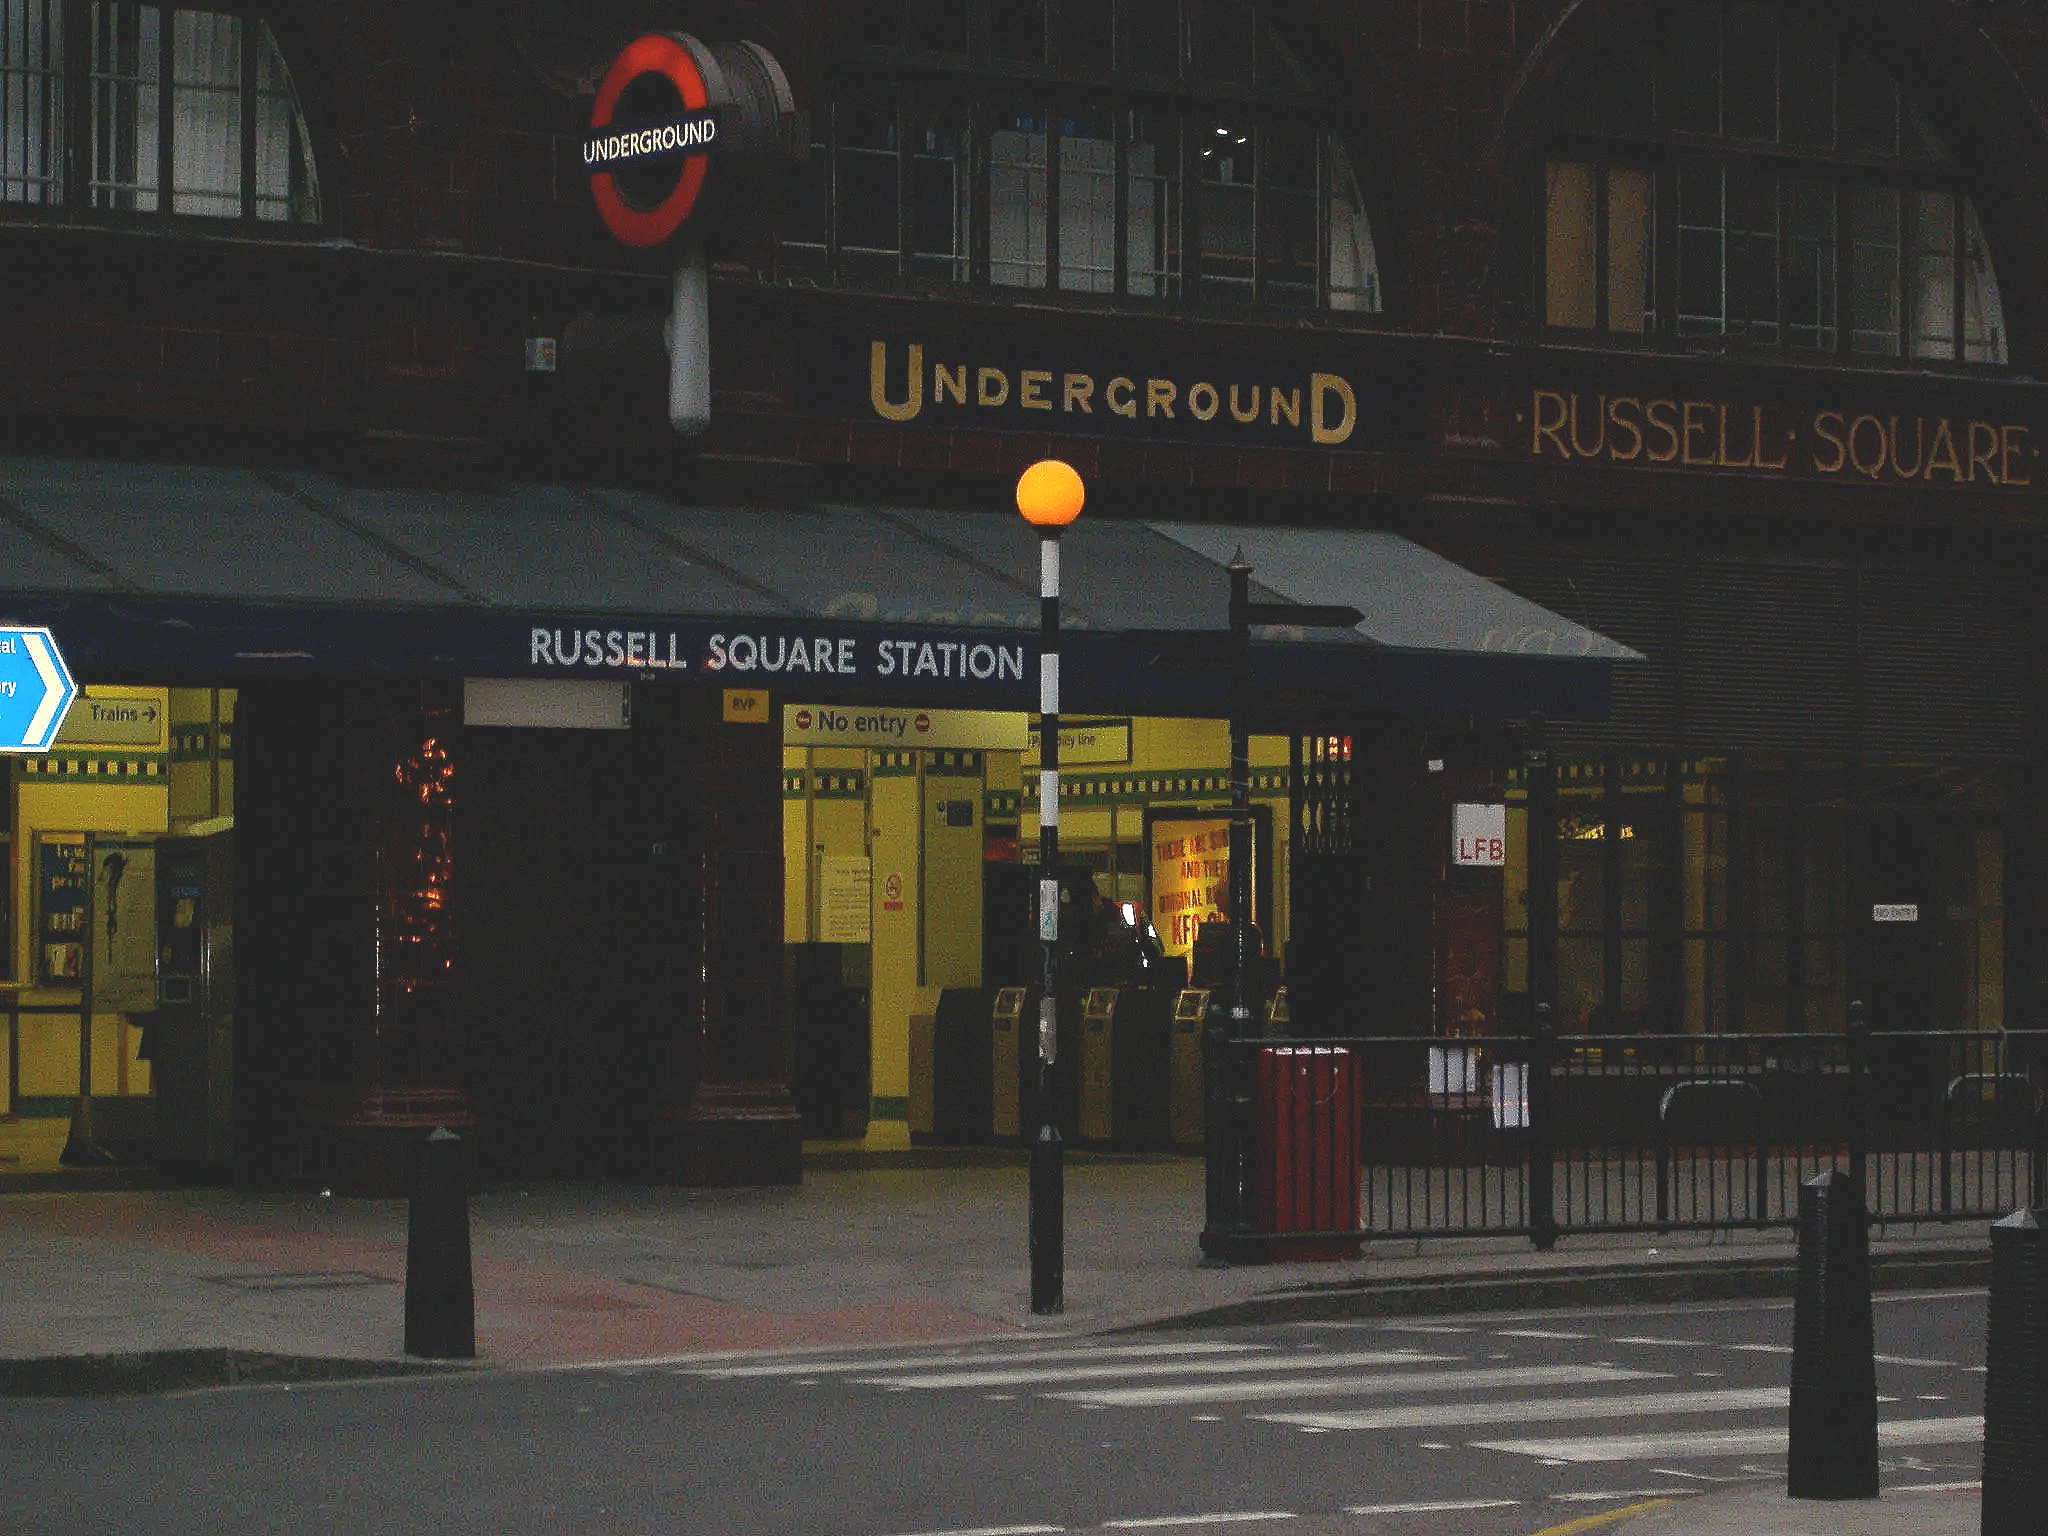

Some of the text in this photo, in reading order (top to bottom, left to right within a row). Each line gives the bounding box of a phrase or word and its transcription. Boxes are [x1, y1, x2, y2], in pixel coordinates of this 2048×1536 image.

[583, 119, 715, 164] UNDERGROUND
[871, 340, 1358, 445] UNDERGROUND
[1532, 389, 2032, 486] RUSSELL SQUARE
[0, 637, 17, 654] al
[530, 626, 1024, 681] RUSSELL SQUARE STATION
[91, 704, 138, 721] Trains
[818, 710, 908, 738] No entry
[1460, 838, 1503, 861] LFB
